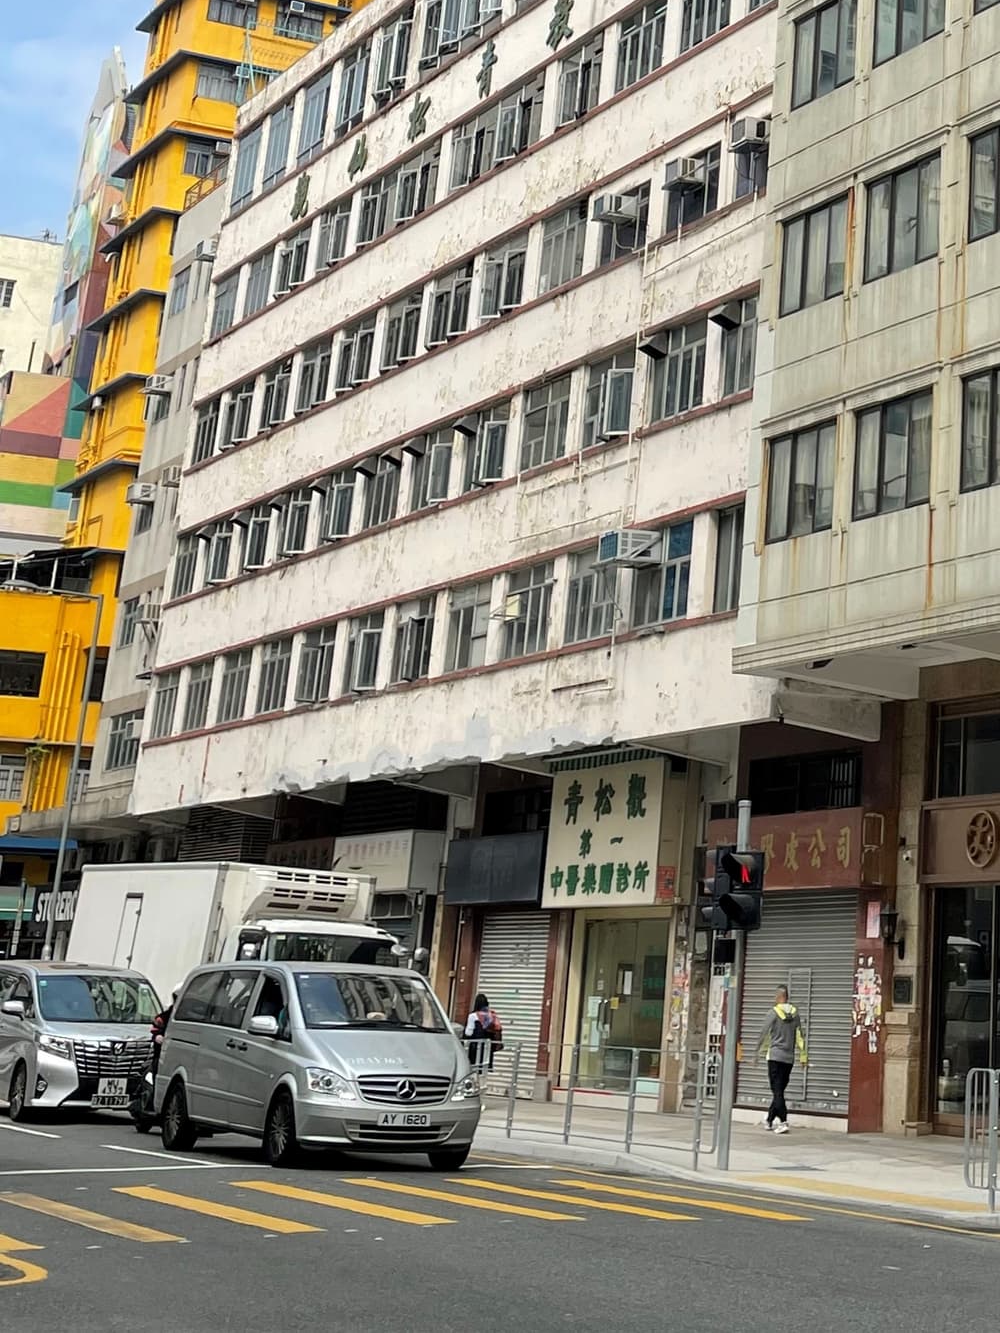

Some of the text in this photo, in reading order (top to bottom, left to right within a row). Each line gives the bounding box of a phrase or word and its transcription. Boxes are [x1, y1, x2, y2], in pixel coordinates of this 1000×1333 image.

[563, 773, 647, 826] 青松觀
[579, 828, 624, 859] 第一
[382, 1114, 427, 1125] AY 1620
